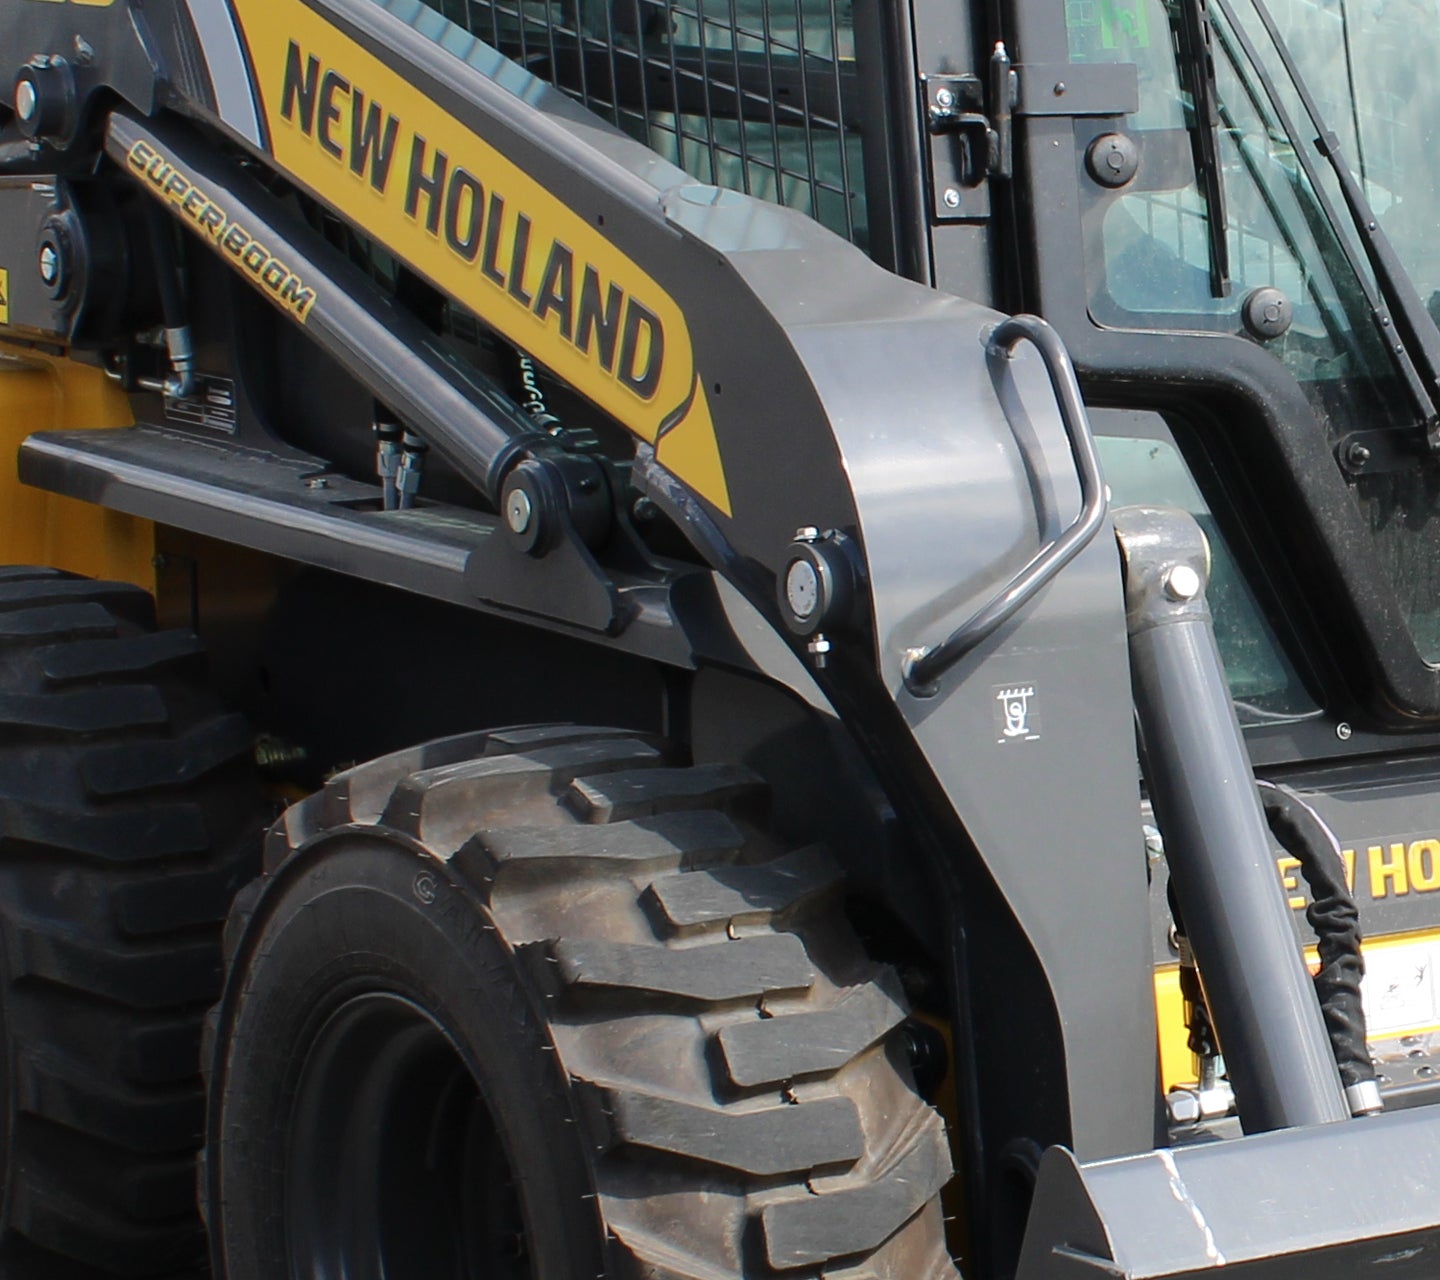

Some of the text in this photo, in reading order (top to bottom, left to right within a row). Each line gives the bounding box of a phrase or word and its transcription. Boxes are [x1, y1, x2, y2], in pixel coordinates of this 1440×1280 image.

[127, 140, 317, 325] SUPER BOOM
[280, 38, 666, 402] NEW HOLLAND
